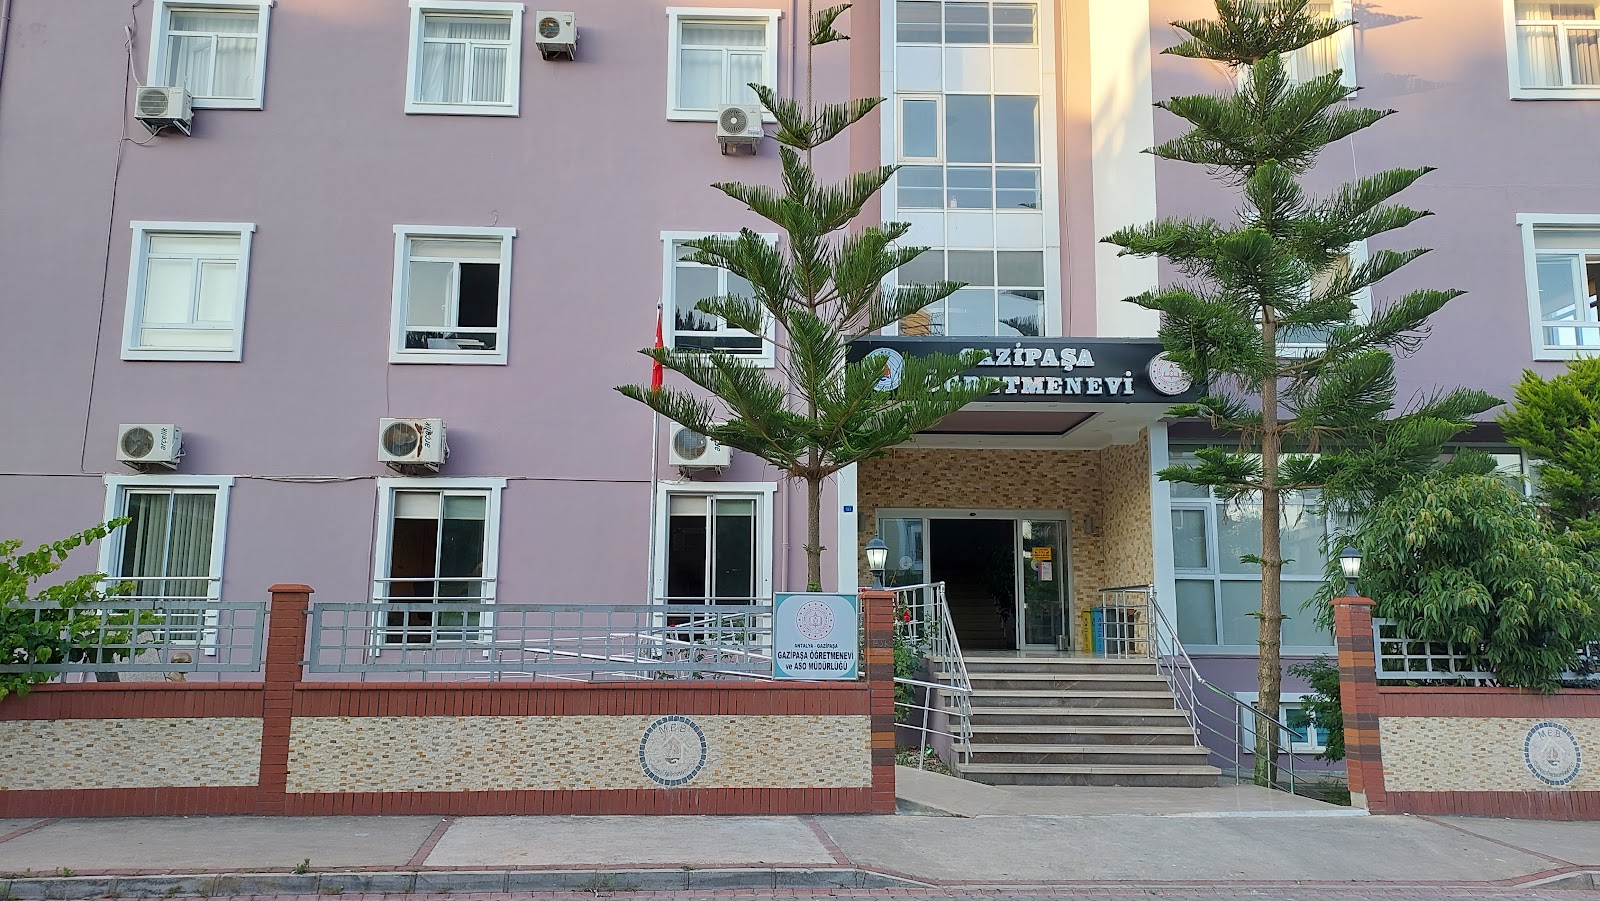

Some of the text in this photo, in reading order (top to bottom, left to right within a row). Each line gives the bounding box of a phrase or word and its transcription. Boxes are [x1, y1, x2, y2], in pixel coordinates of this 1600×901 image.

[817, 642, 838, 650] GAZİPAŞA
[777, 649, 854, 661] GAZİPAŞA ÖĞRETMENEVİ
[794, 662, 807, 670] ASO
[808, 661, 848, 671] MÜDÜRLÜĞÜ
